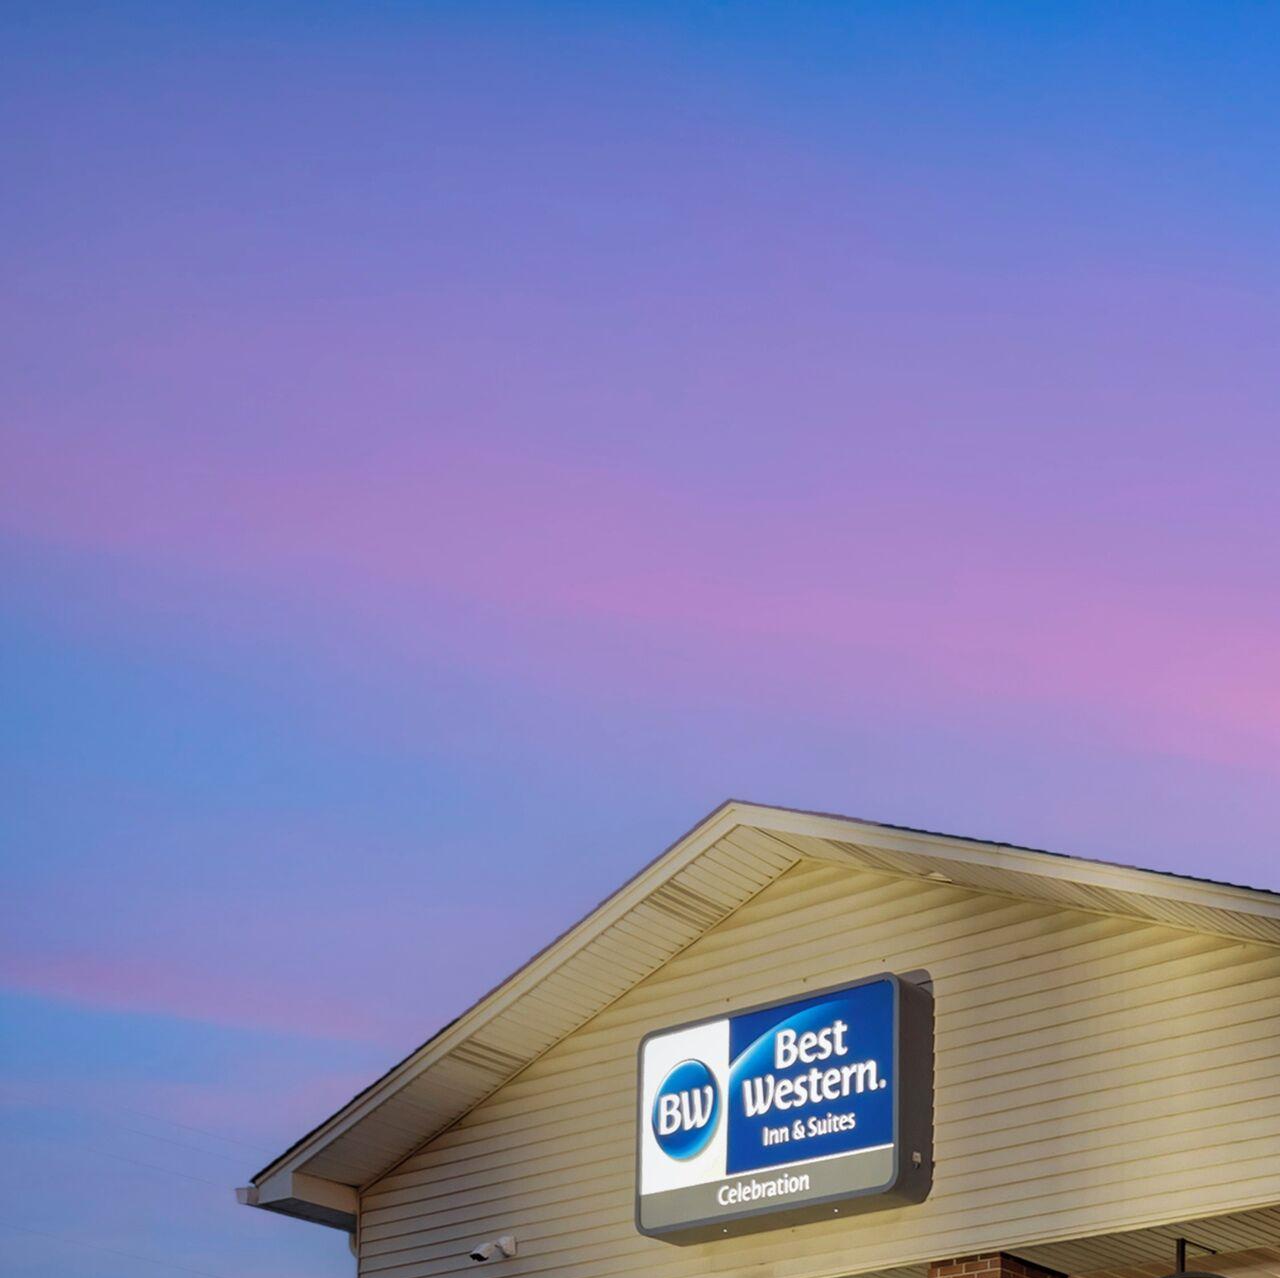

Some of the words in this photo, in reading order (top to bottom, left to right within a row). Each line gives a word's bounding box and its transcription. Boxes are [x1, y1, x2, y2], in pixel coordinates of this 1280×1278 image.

[775, 1020, 848, 1069] Best
[658, 1085, 713, 1135] BW
[763, 1126, 789, 1146] Inn
[792, 1119, 805, 1140] &
[807, 1112, 856, 1137] Suites
[717, 1173, 810, 1206] Celebration
